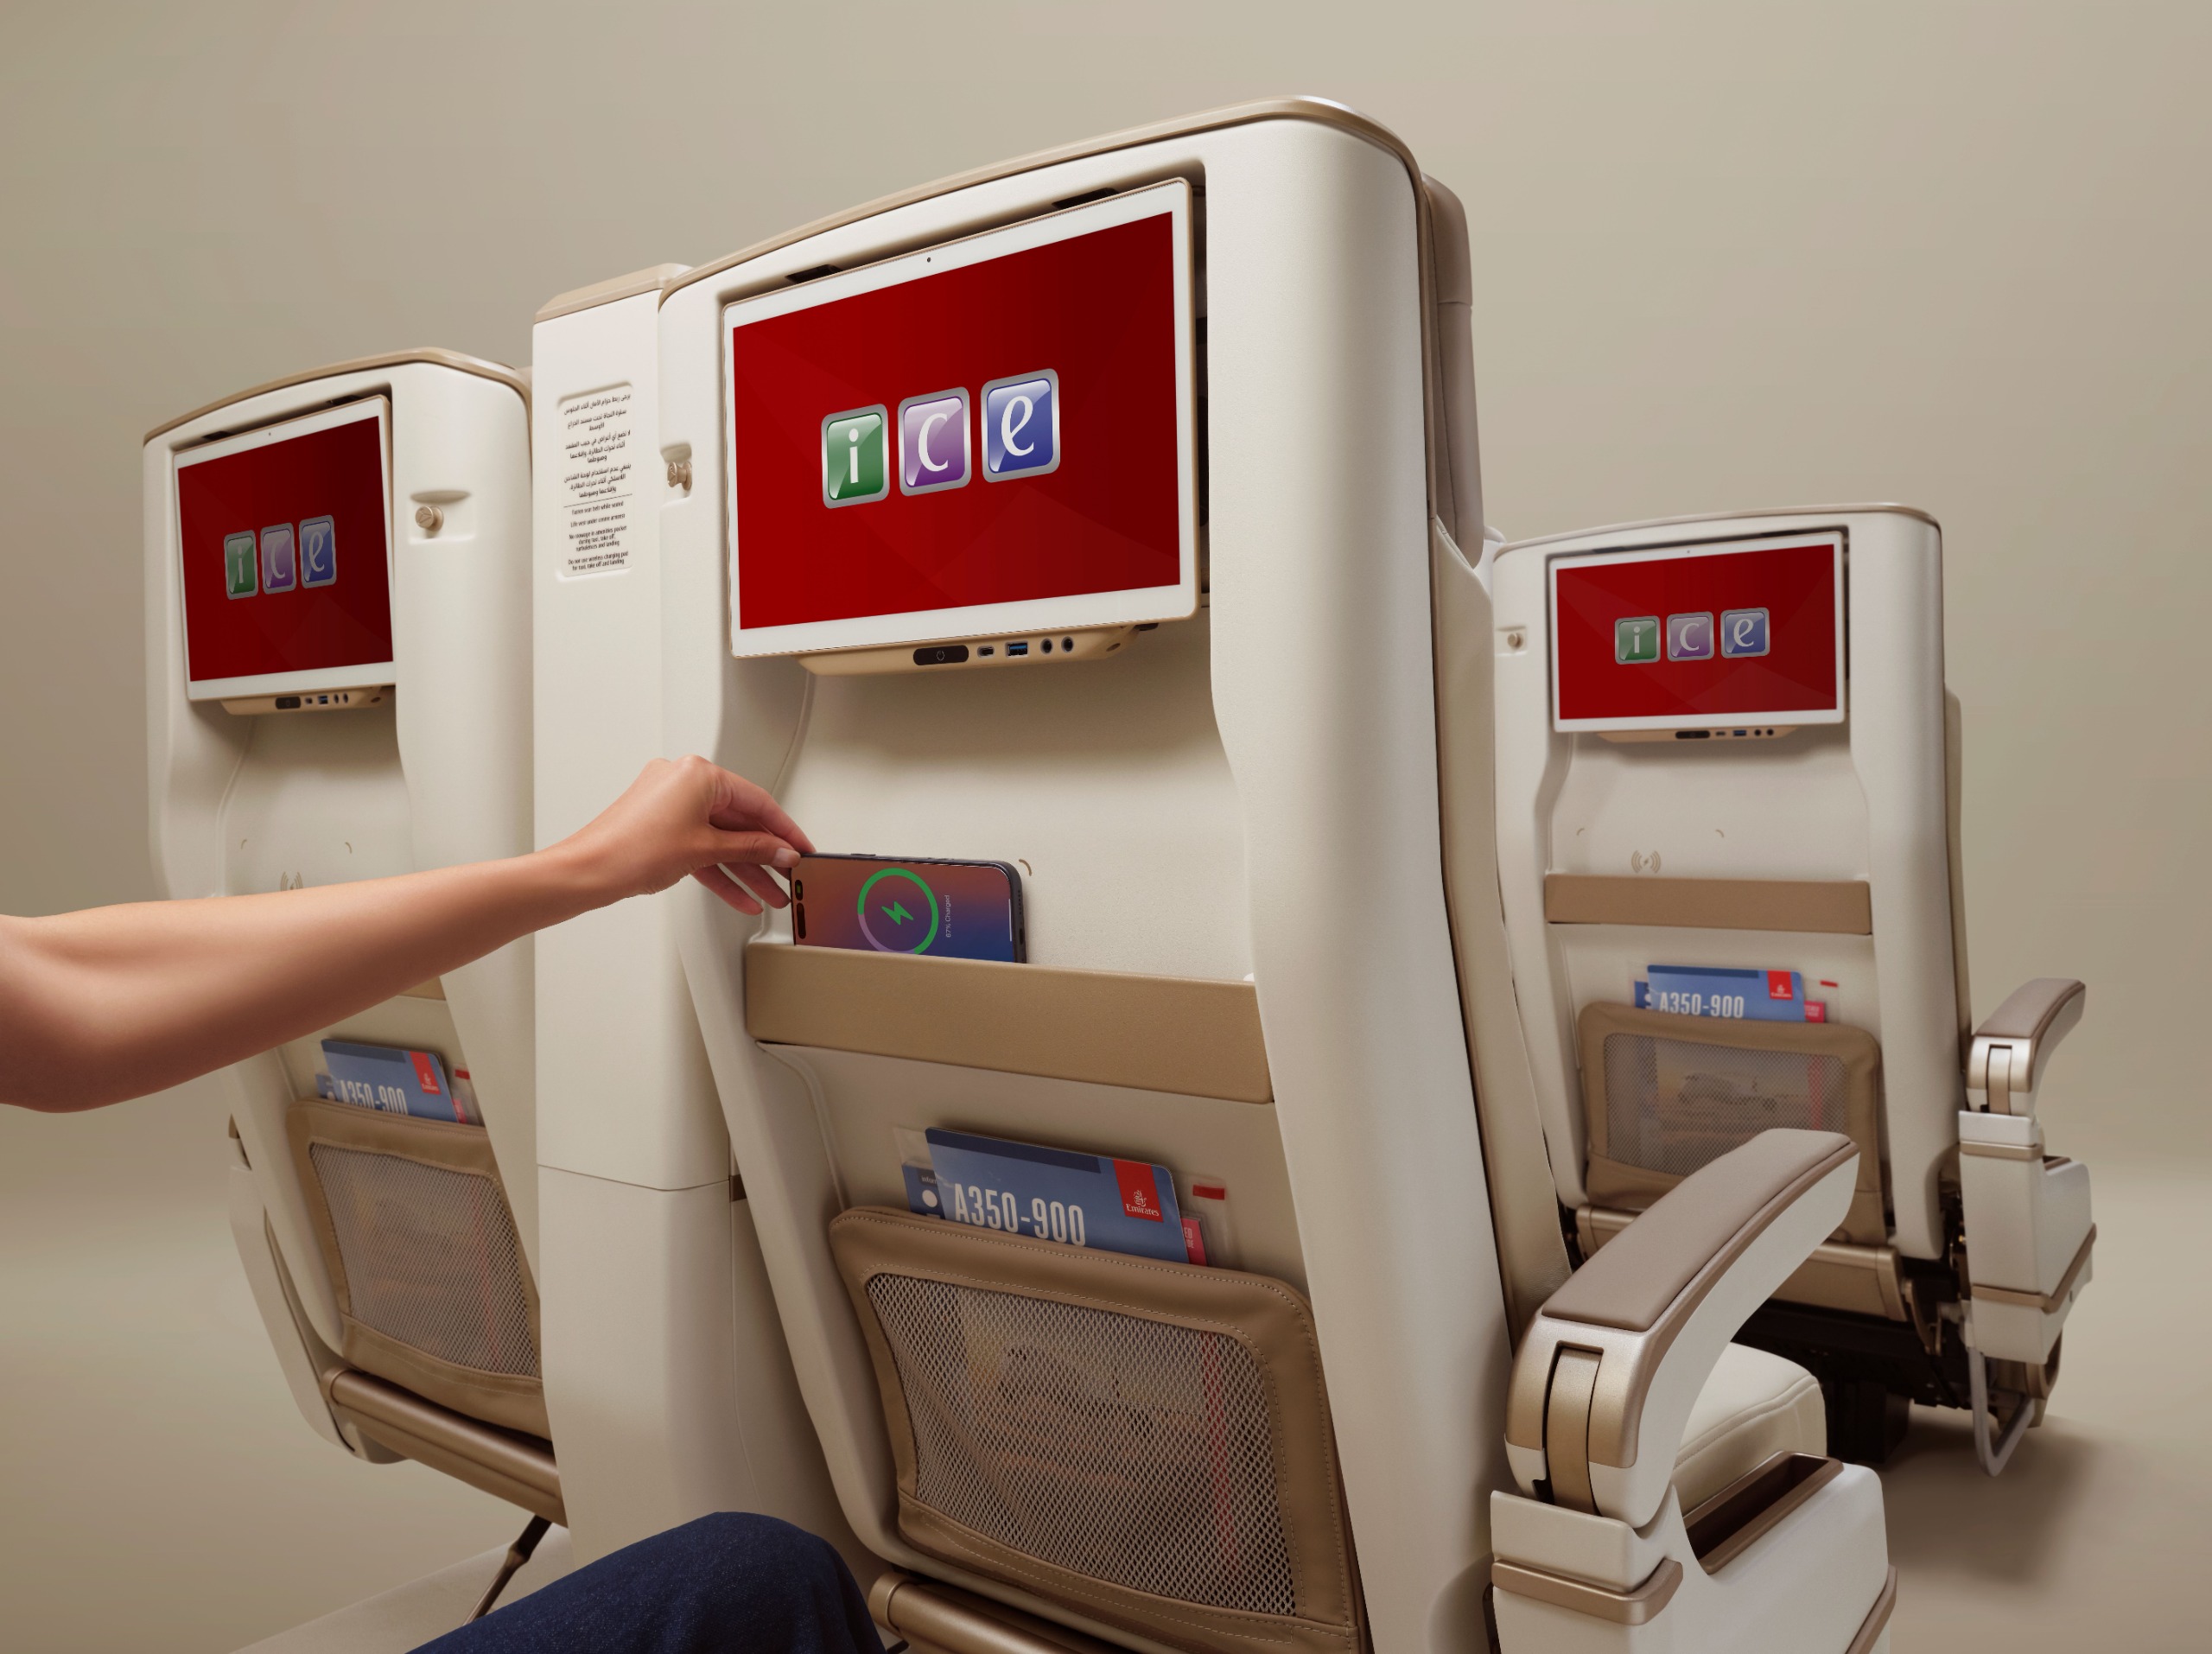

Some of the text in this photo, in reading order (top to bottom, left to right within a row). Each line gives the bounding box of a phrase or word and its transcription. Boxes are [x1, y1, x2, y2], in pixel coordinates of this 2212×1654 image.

[1659, 991, 1745, 1019] A350-900
[955, 1183, 1086, 1247] A350-900
[1125, 1203, 1160, 1218] Emirates
